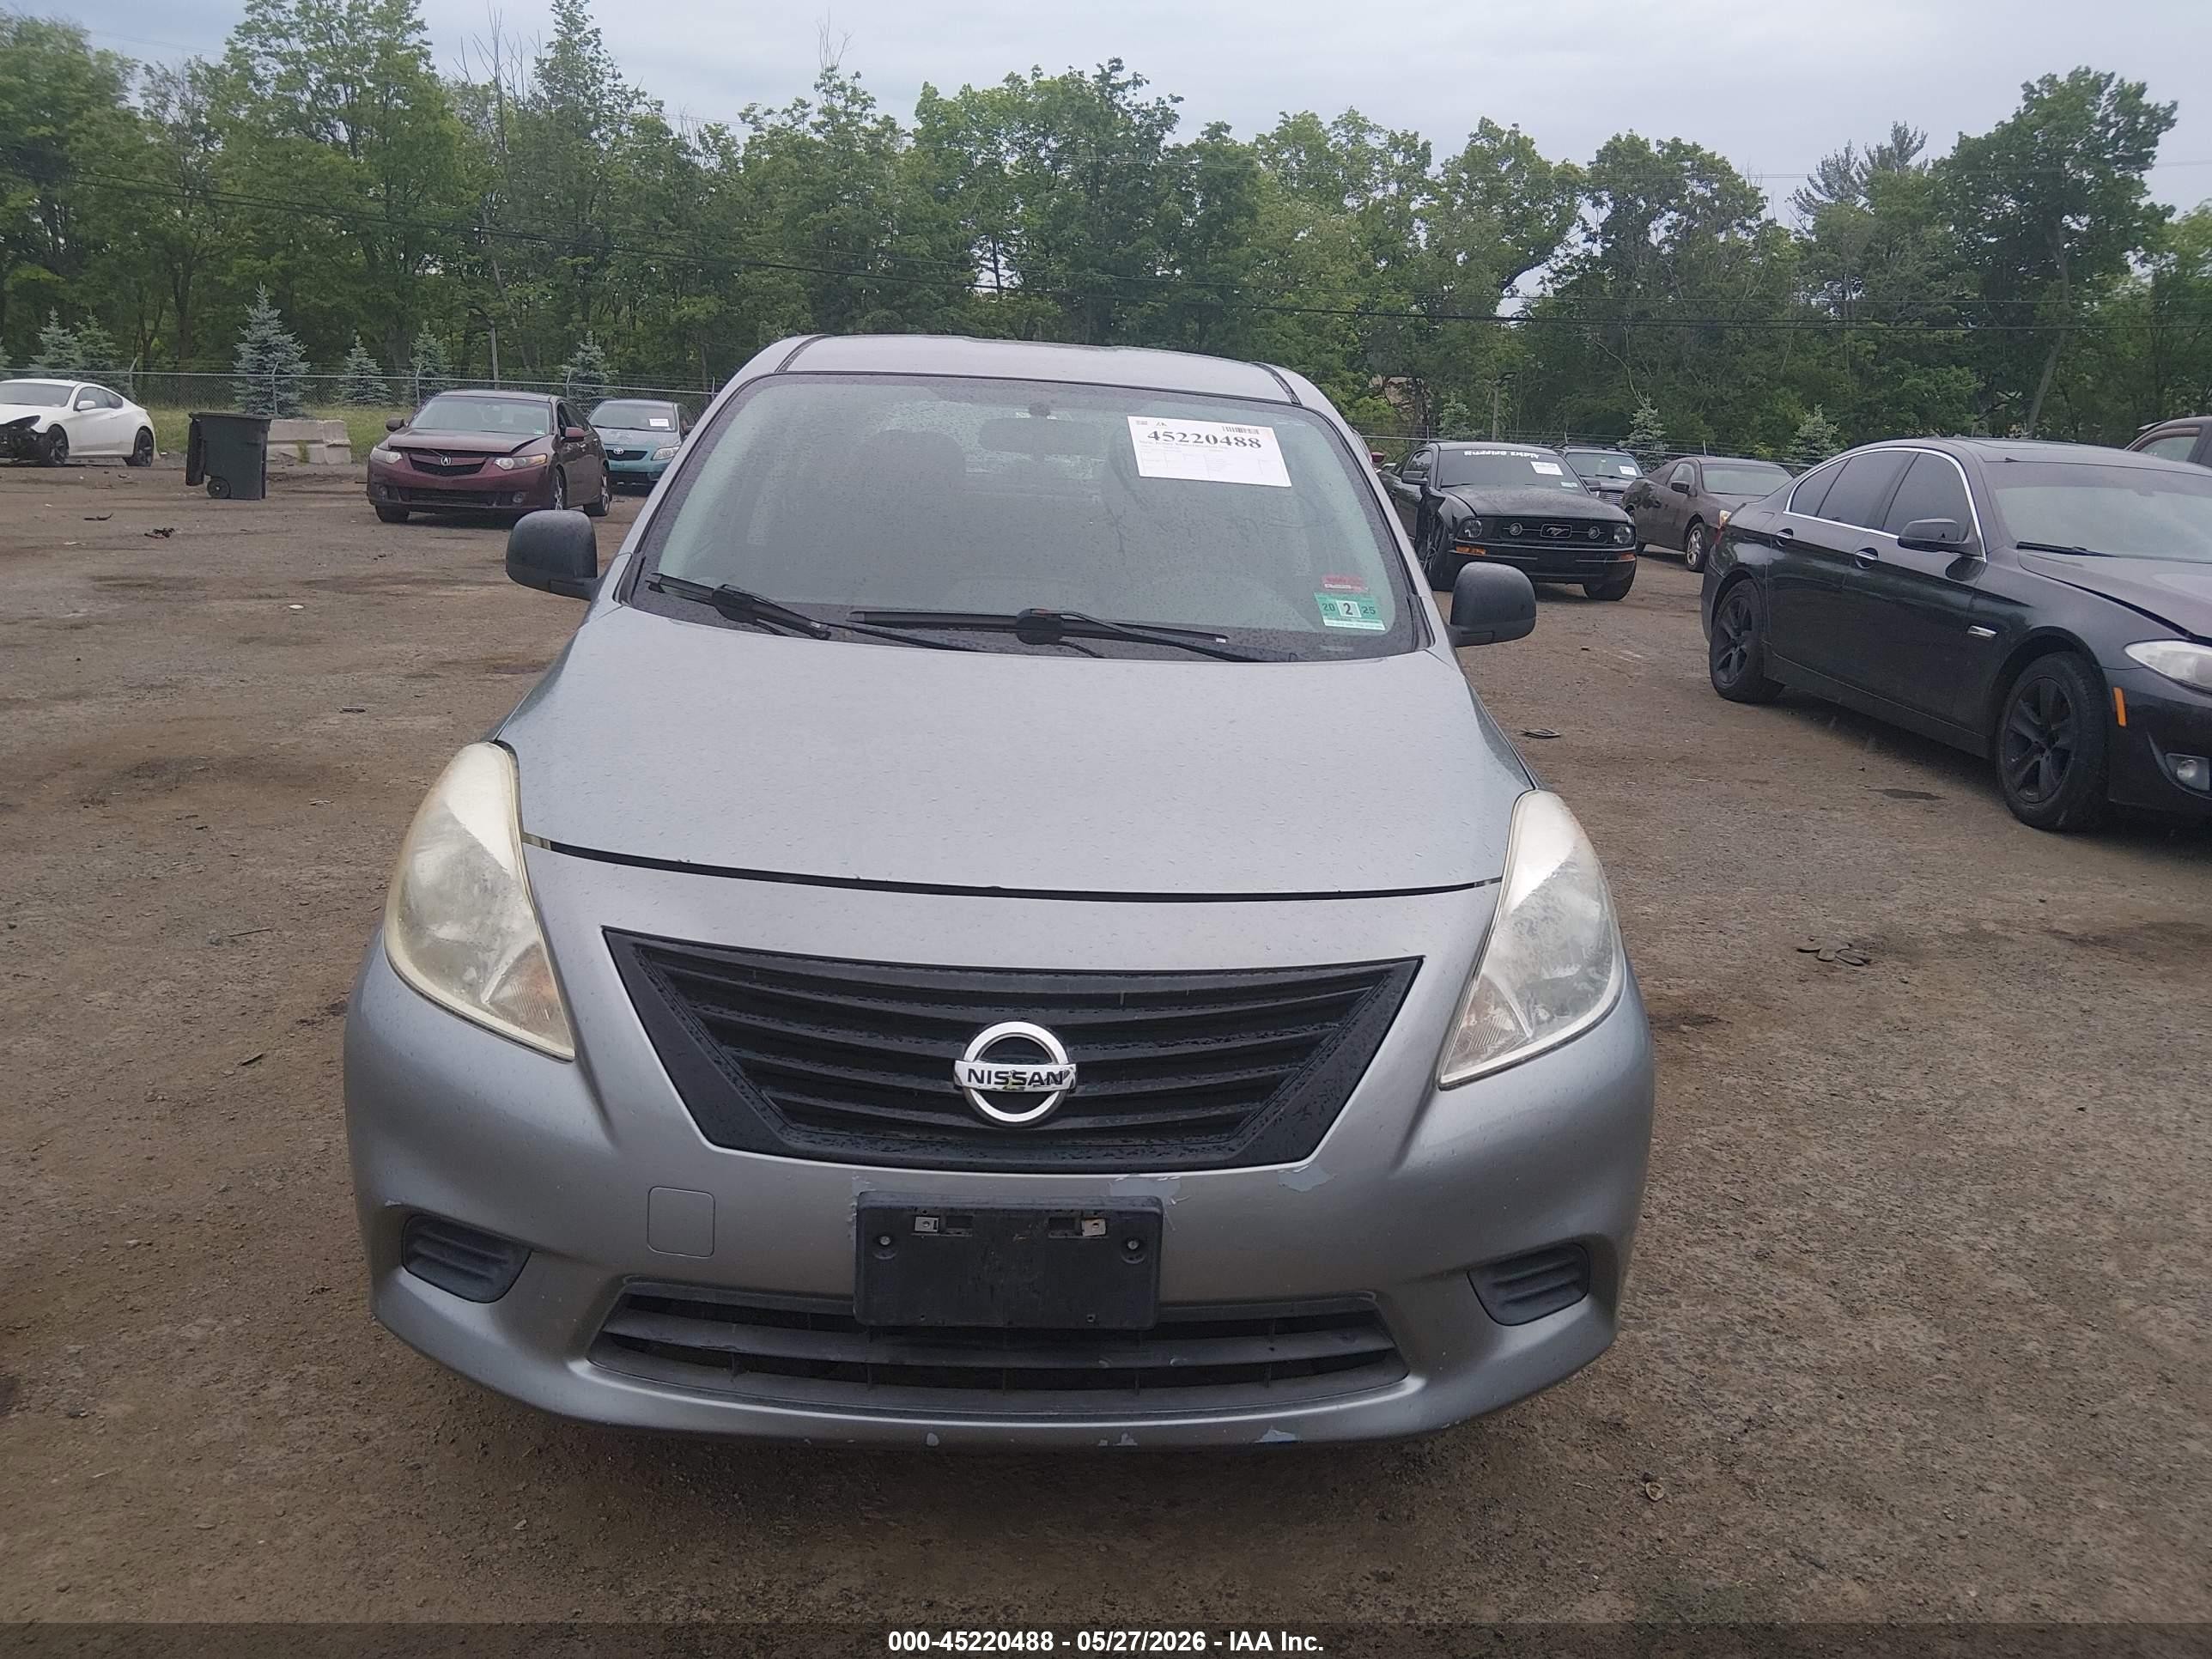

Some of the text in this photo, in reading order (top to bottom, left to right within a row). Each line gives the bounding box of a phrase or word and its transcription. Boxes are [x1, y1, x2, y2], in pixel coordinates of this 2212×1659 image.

[1147, 430, 1262, 448] 45220488
[1322, 602, 1376, 616] 20 2 25
[968, 1068, 1064, 1086] NISSAN
